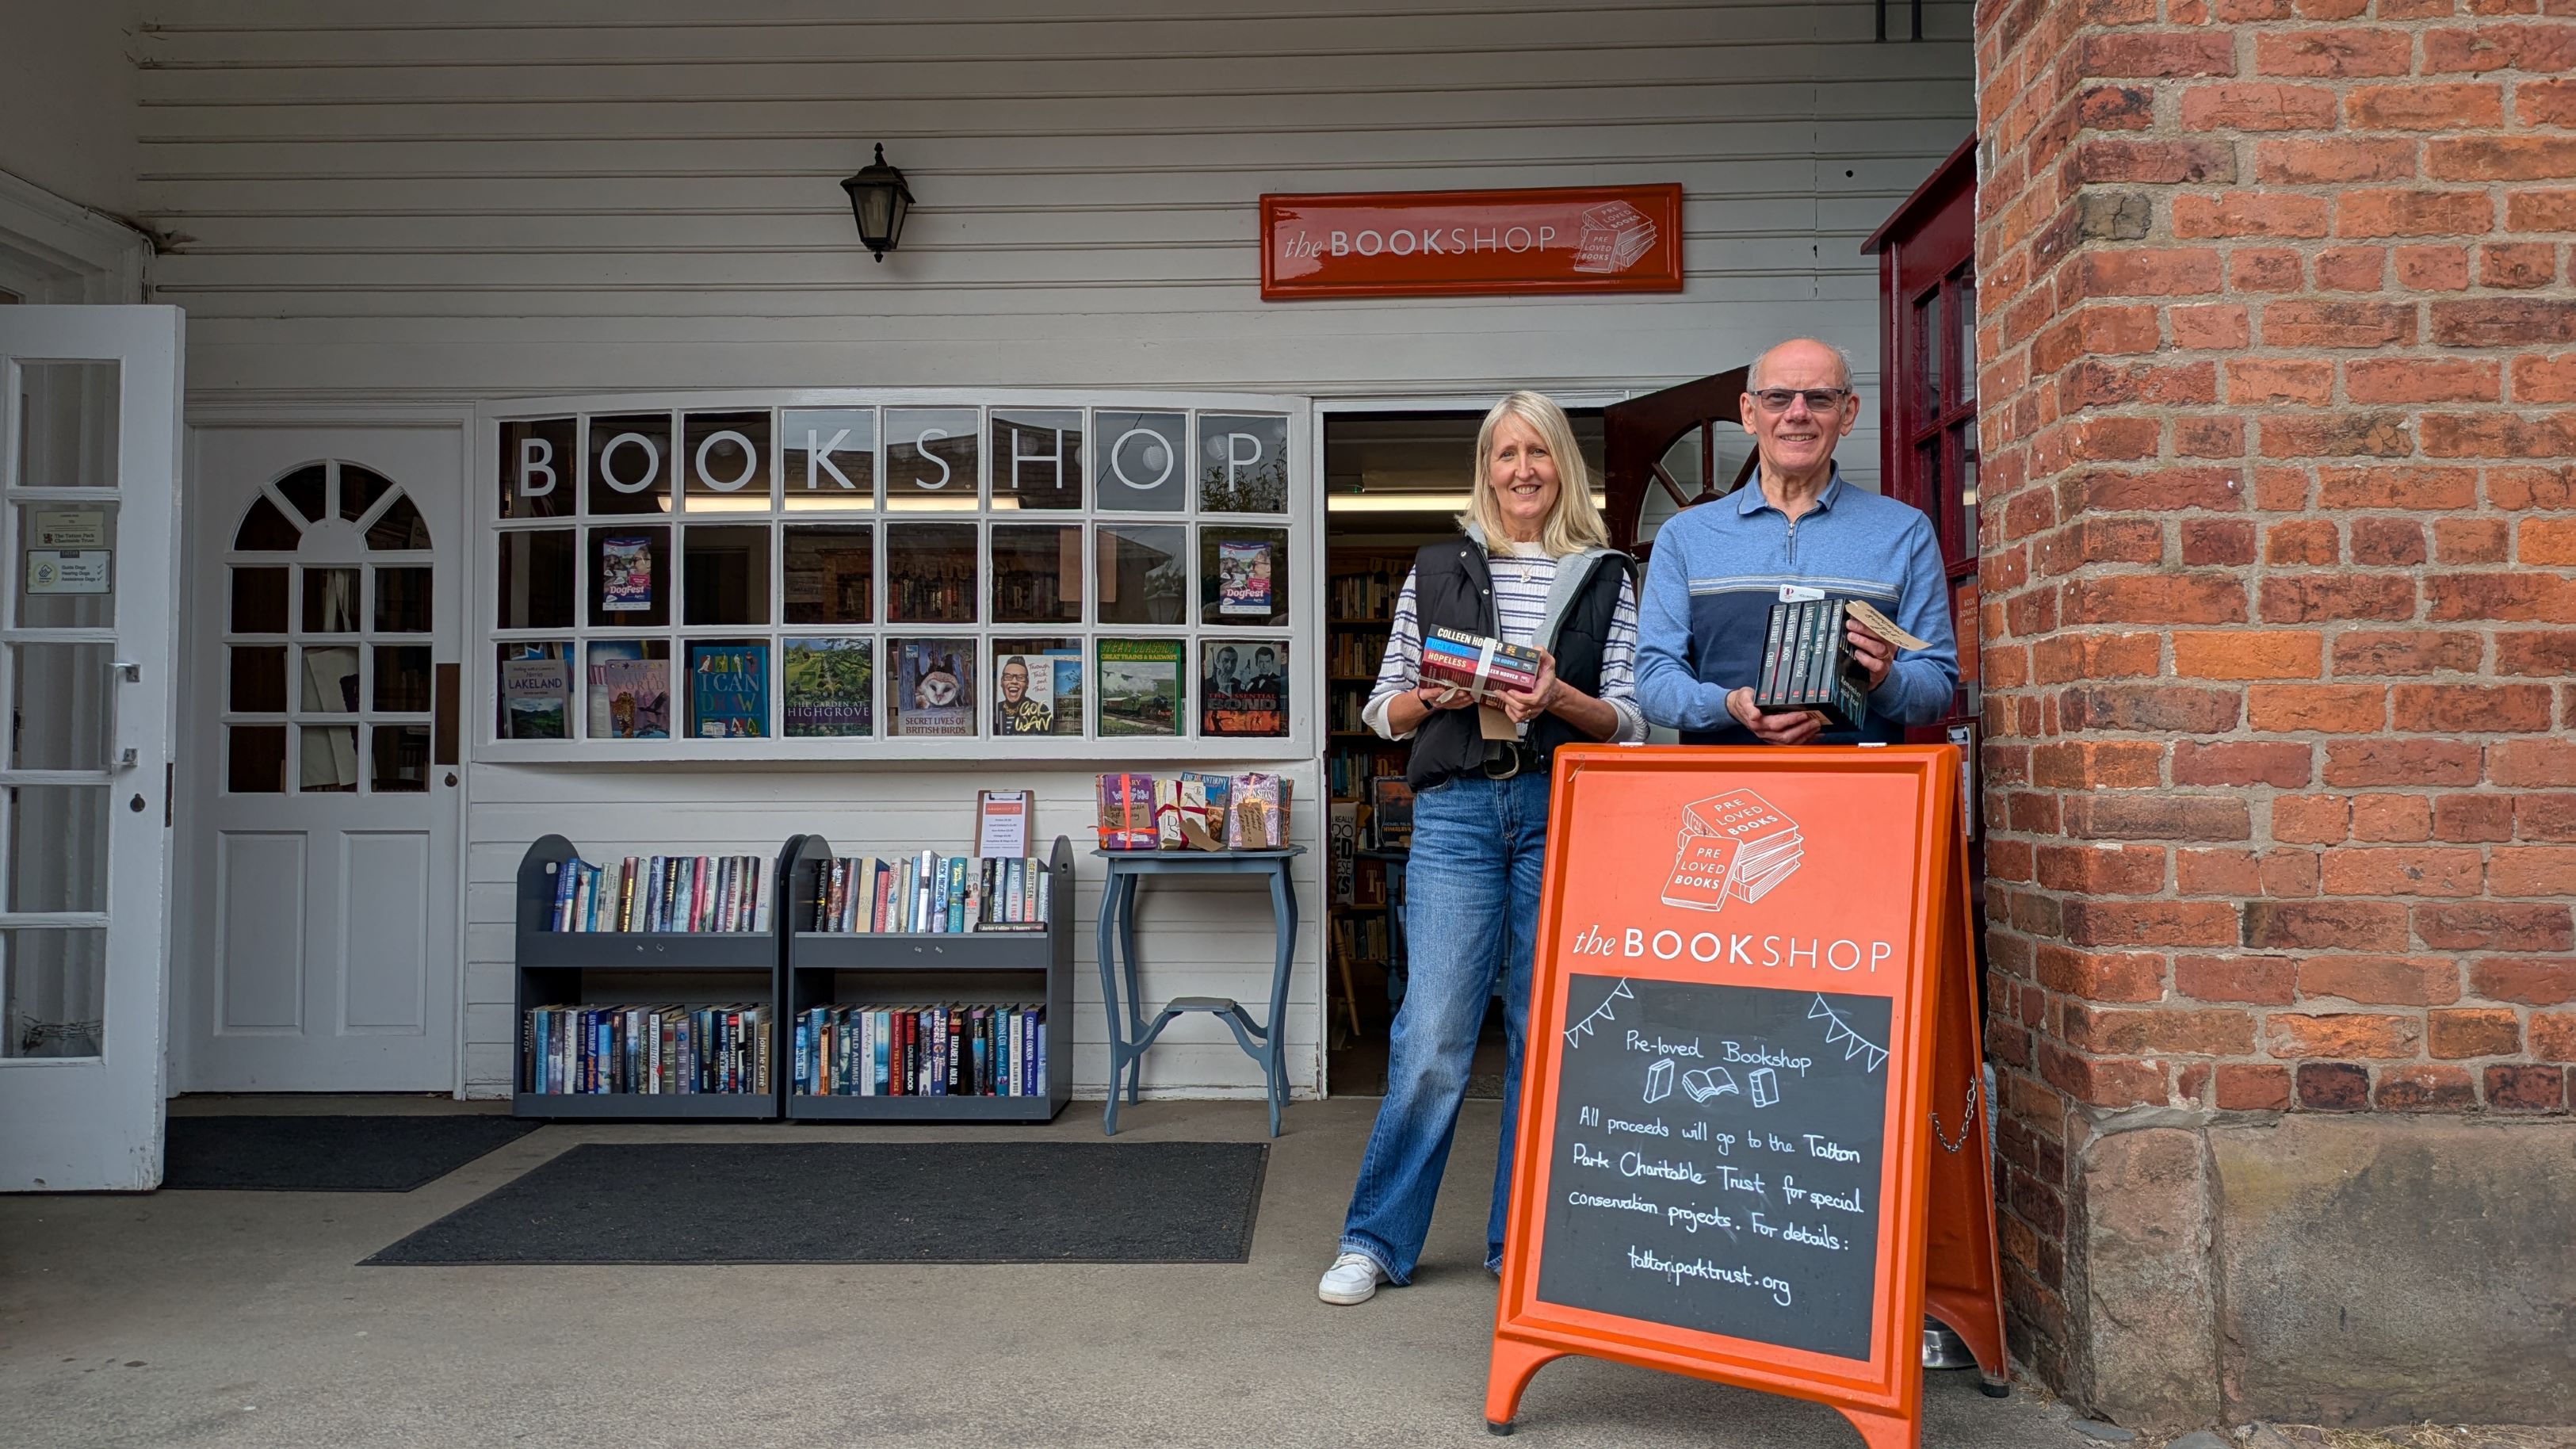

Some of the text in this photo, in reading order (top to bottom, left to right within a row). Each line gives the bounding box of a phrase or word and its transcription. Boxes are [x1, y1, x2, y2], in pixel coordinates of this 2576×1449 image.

[1611, 216, 1641, 228] BOOKS
[1284, 225, 1557, 258] the BOOKSHOP
[610, 586, 644, 596] DogFest
[1227, 589, 1264, 599] DogFest
[1964, 598, 1976, 607] BOOK
[1787, 609, 1798, 623] JAMES
[1806, 606, 1815, 621] JAMES
[1959, 607, 1978, 617] DONATIO
[1964, 617, 1977, 626] POINT
[1437, 628, 1472, 645] COLLEEN
[1766, 610, 1783, 667] JAMES HERBERT CREED
[1785, 624, 1794, 642] HERBERT
[1802, 622, 1812, 640] HERBERT
[1101, 640, 1177, 653] STEAM CLASSICS
[1431, 640, 1469, 656] UGLY LOVE
[1028, 662, 1052, 671] Through
[1428, 652, 1467, 668] HOPELESS
[509, 678, 562, 689] LAKELAND
[613, 680, 665, 690] WORLD
[702, 674, 760, 692] I CAN
[787, 707, 869, 717] HIGHGROVE
[1019, 702, 1050, 716] GOK
[1208, 699, 1276, 710] BOND
[906, 717, 933, 725] SECRET
[1015, 714, 1053, 732] WAN
[1257, 789, 1273, 801] SHAN
[1714, 798, 1745, 813] PRE
[1715, 805, 1764, 826] LOVED
[1726, 814, 1779, 836] BOOKS
[1696, 847, 1722, 859] PRE
[1680, 859, 1726, 874] LOVED
[566, 877, 575, 895] SHIELDS
[1674, 875, 1720, 889] BOOKS
[1573, 925, 1892, 973] the BOOKSHOP
[996, 1011, 1007, 1035] JOSEPHINE
[950, 1035, 959, 1065] ELIZABETH
[1626, 1030, 1812, 1077] Pre-loved Bookshop
[1579, 1106, 1860, 1164] All proceeds will go to the Tatton
[1573, 1142, 1864, 1214] Park Charitable Trust for special
[1569, 1191, 1850, 1252] conservation projects. For details:
